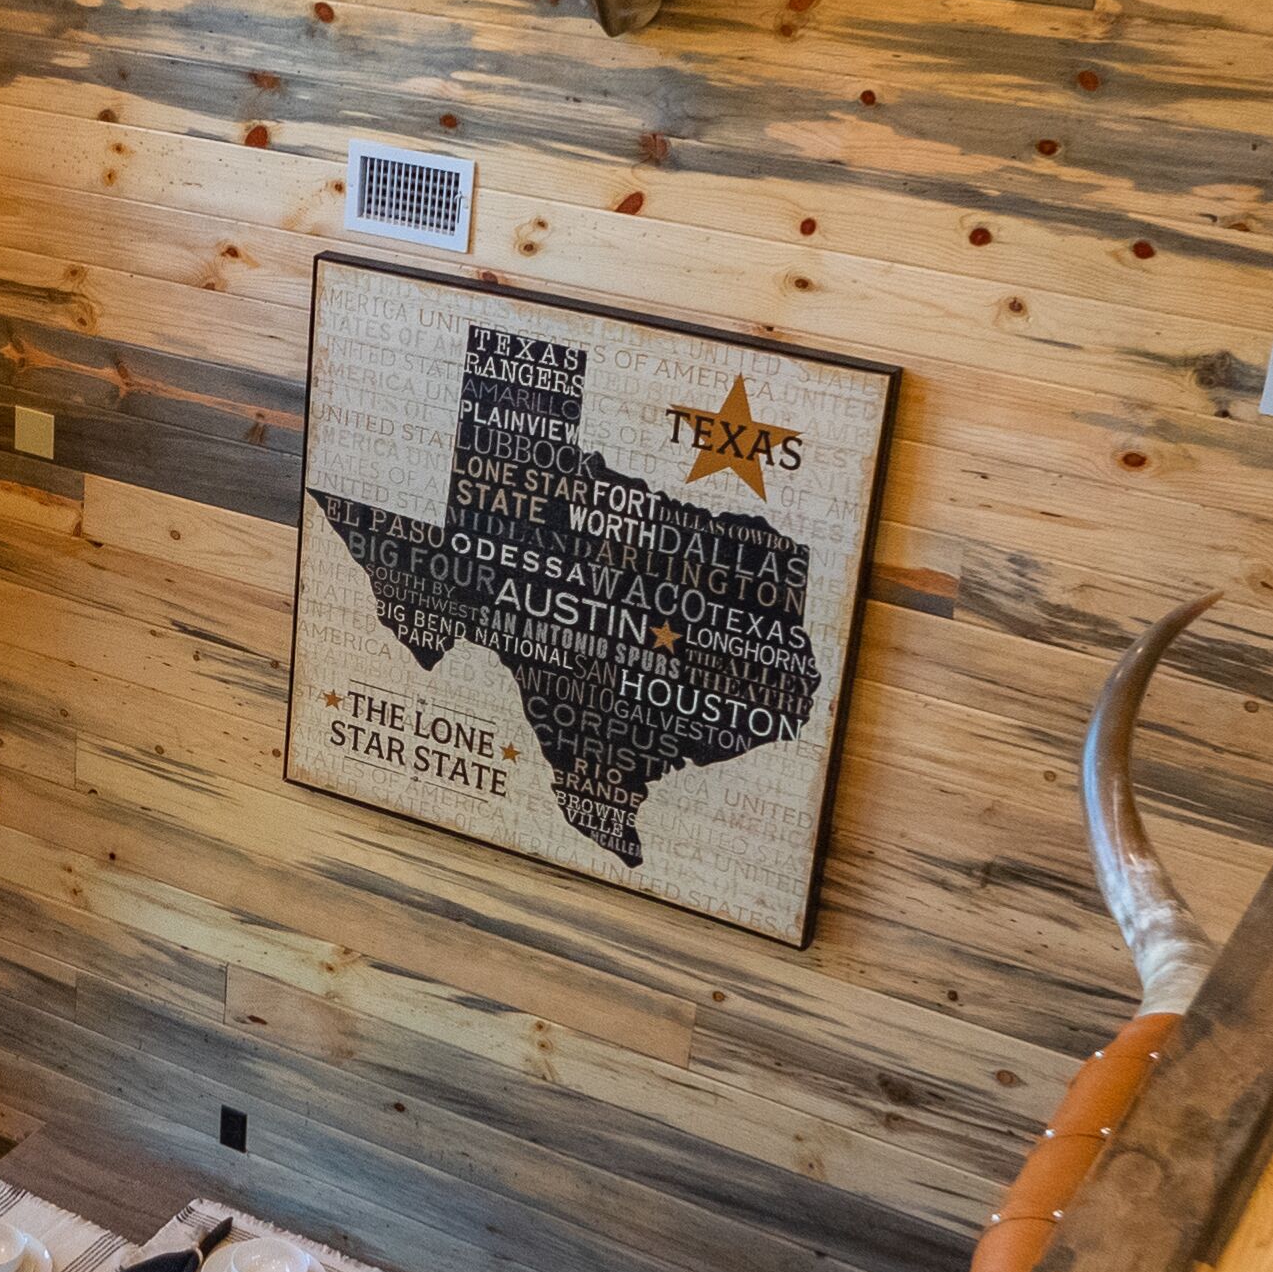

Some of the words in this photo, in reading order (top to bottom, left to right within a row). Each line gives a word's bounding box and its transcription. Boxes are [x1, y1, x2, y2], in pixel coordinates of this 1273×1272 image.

[464, 352, 585, 398] RANGERS
[474, 328, 578, 371] TEXAS
[460, 399, 579, 445] PLAINVIEW
[462, 378, 581, 420] AMARILLO
[456, 422, 594, 479] LUBBOCK
[665, 408, 804, 471] TEXAS
[453, 452, 519, 487] LONE
[524, 469, 588, 505] STAR
[456, 479, 549, 525] STATE
[593, 480, 661, 521] FORT
[325, 495, 360, 527] EL
[368, 507, 446, 548] PASO
[447, 505, 592, 558] MIDLAND
[569, 504, 656, 551] WORTH
[659, 506, 725, 537] DALLAS
[728, 524, 810, 556] COWBOYS
[348, 530, 399, 567] BIG
[410, 547, 496, 595] FOUR
[364, 561, 426, 592] SOUTH
[432, 579, 457, 598] BY
[451, 532, 585, 586] ODESSA
[595, 540, 806, 616] ARLINGTON
[658, 525, 807, 588] DALLAS
[373, 581, 479, 621] SOUTHWEST
[495, 578, 648, 645] AUSTIN
[588, 561, 706, 623] WACO
[377, 599, 406, 623] BIG
[414, 609, 466, 640] BEND
[474, 627, 573, 670] NATIONAL
[397, 624, 448, 653] PARK
[480, 606, 517, 633] SAN
[522, 617, 608, 660] ANTONIO
[615, 641, 681, 680] SPURS
[686, 623, 821, 678] LONGHORNS
[707, 602, 806, 649] TEXAS
[514, 663, 615, 713] ANTONIO
[573, 653, 618, 689] SAN
[684, 665, 815, 717] THEATRE
[685, 647, 723, 670] THE
[722, 658, 817, 698] ALLEY
[347, 690, 406, 732] THE
[414, 710, 495, 759] LONE
[527, 695, 679, 758] CORPUS
[614, 700, 752, 754] GALVESTON
[619, 668, 803, 742] HOUSTON
[329, 719, 405, 766] STAR
[413, 745, 507, 798] STATE
[534, 723, 667, 777] CHRISTI
[574, 757, 622, 785] RIO
[553, 768, 644, 808] GRANDE
[555, 789, 637, 828] BROWNS
[566, 806, 623, 838] VILLE
